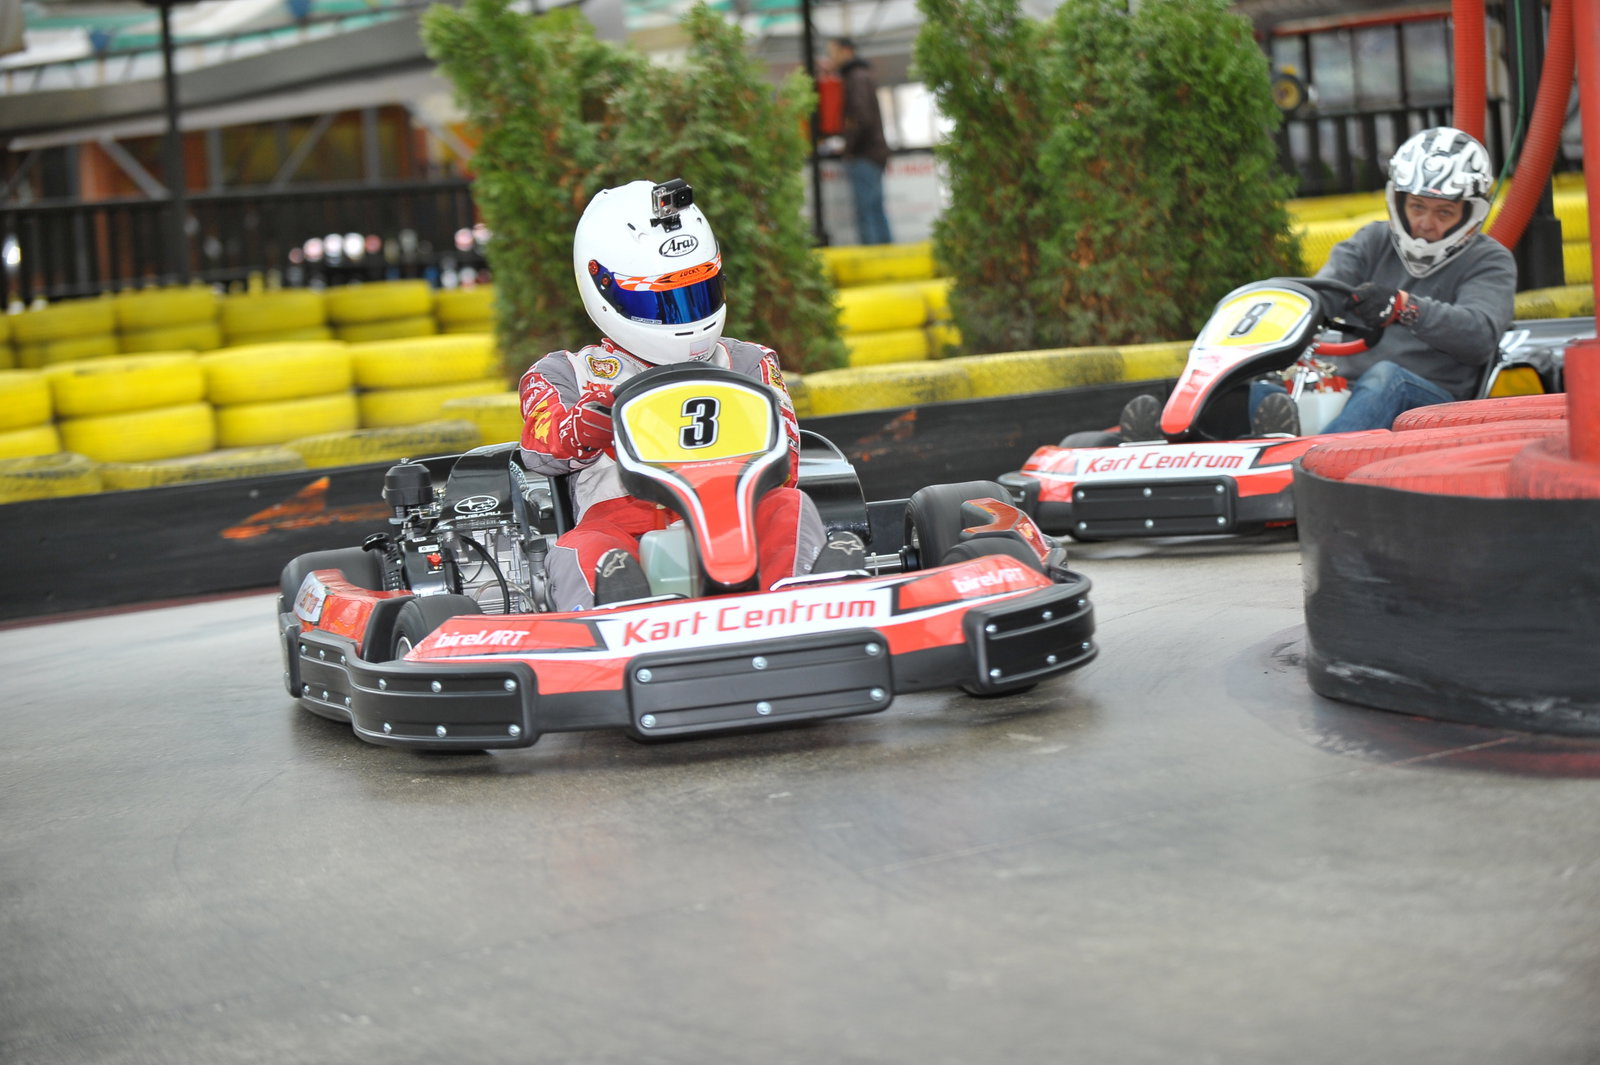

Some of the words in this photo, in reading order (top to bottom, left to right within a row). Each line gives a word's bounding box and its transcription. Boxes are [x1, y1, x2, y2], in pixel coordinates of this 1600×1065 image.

[662, 236, 695, 255] Arai
[1229, 302, 1275, 338] 8
[679, 397, 720, 449] 3
[1084, 453, 1137, 474] Kart
[1139, 451, 1244, 470] Centrum
[455, 510, 501, 520] SUBARU
[623, 613, 707, 646] Kart
[716, 598, 876, 633] Centrum
